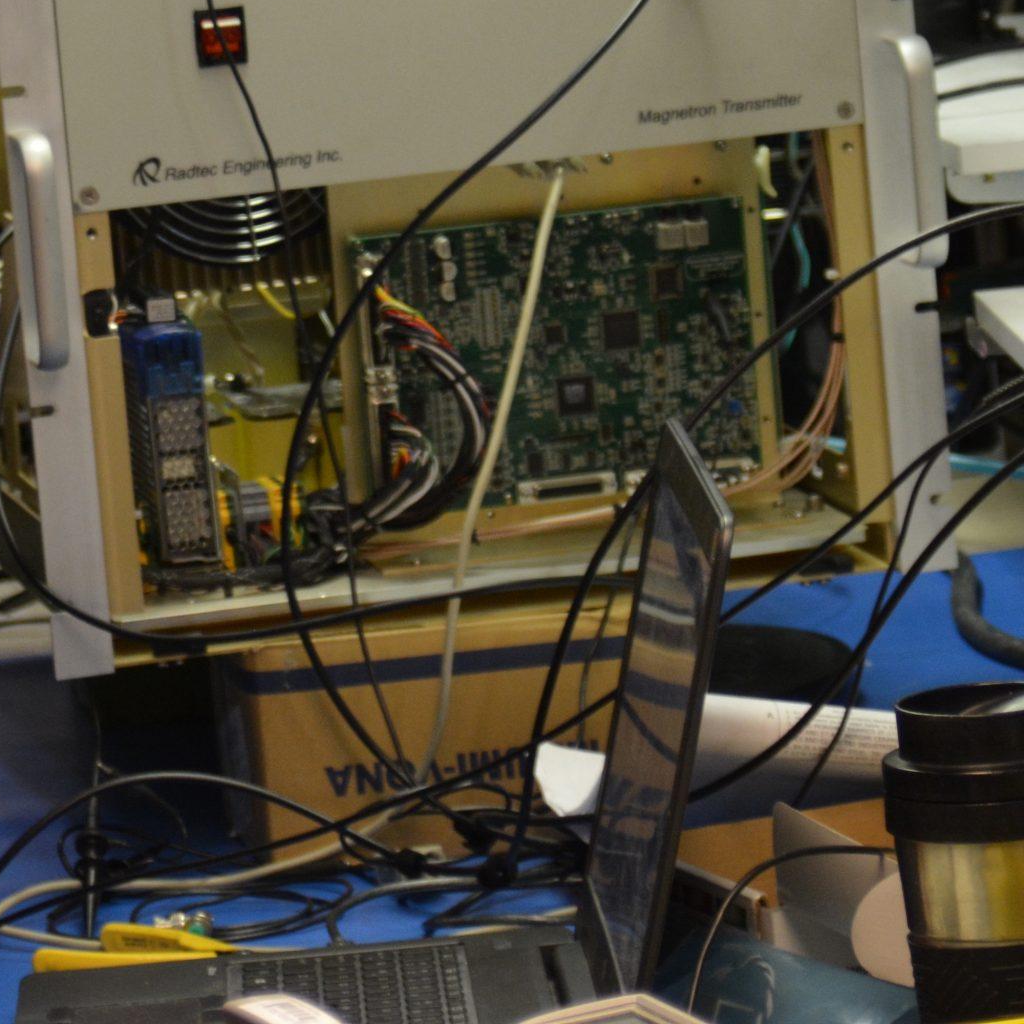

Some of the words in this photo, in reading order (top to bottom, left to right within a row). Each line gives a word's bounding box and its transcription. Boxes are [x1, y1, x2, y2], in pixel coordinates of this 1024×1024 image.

[638, 104, 717, 125] Magnetron
[722, 93, 803, 114] Transmitter
[165, 161, 218, 181] Radtec
[316, 148, 343, 163] Inc.
